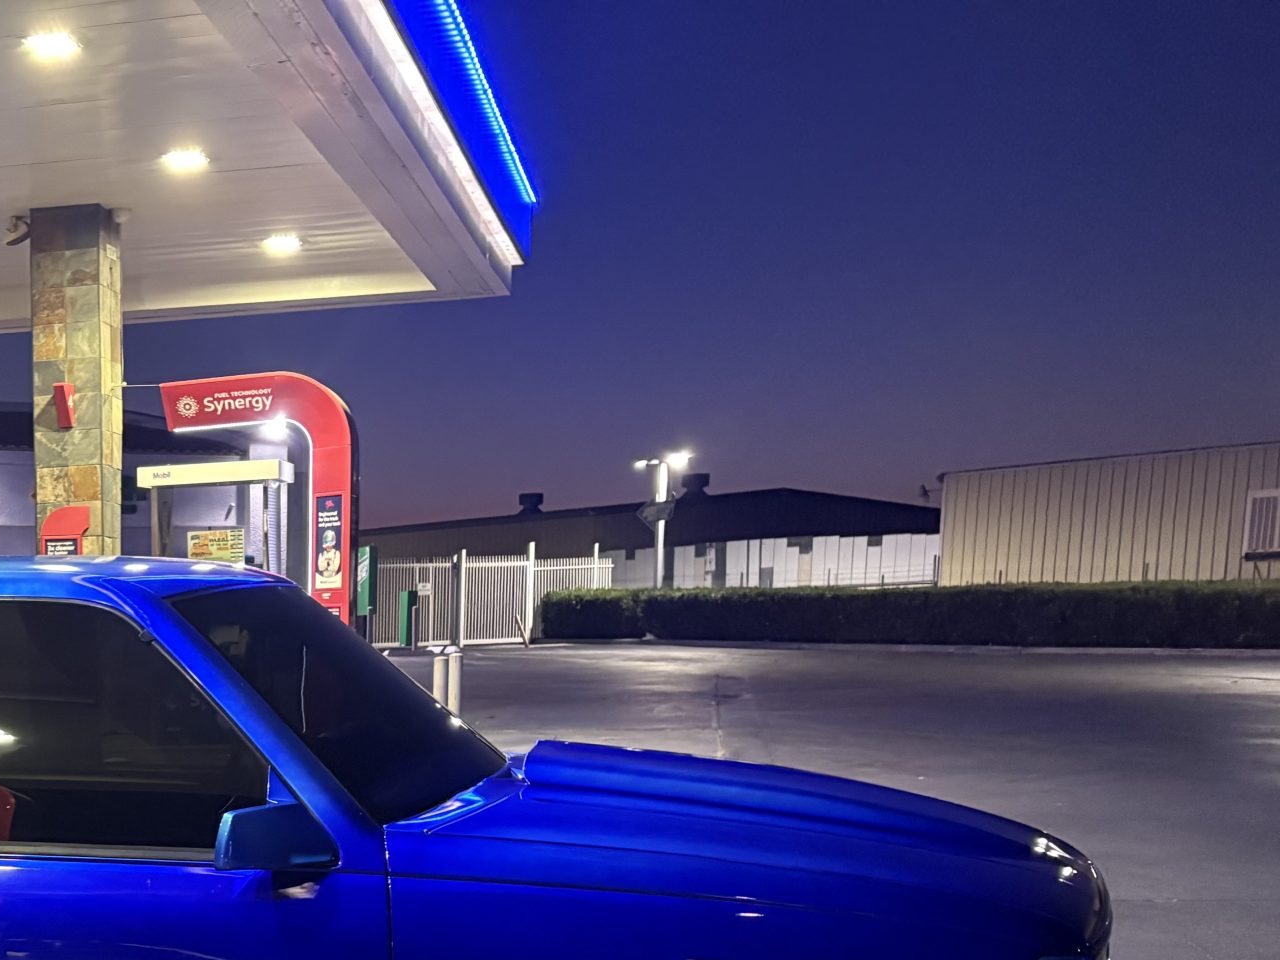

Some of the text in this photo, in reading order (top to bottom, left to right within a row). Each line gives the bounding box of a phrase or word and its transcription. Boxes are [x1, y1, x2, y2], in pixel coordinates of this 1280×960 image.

[214, 388, 272, 398] FUEL TECHNOLOGY
[67, 394, 74, 408] 4
[203, 395, 273, 415] Synergy
[152, 471, 171, 479] Mobil
